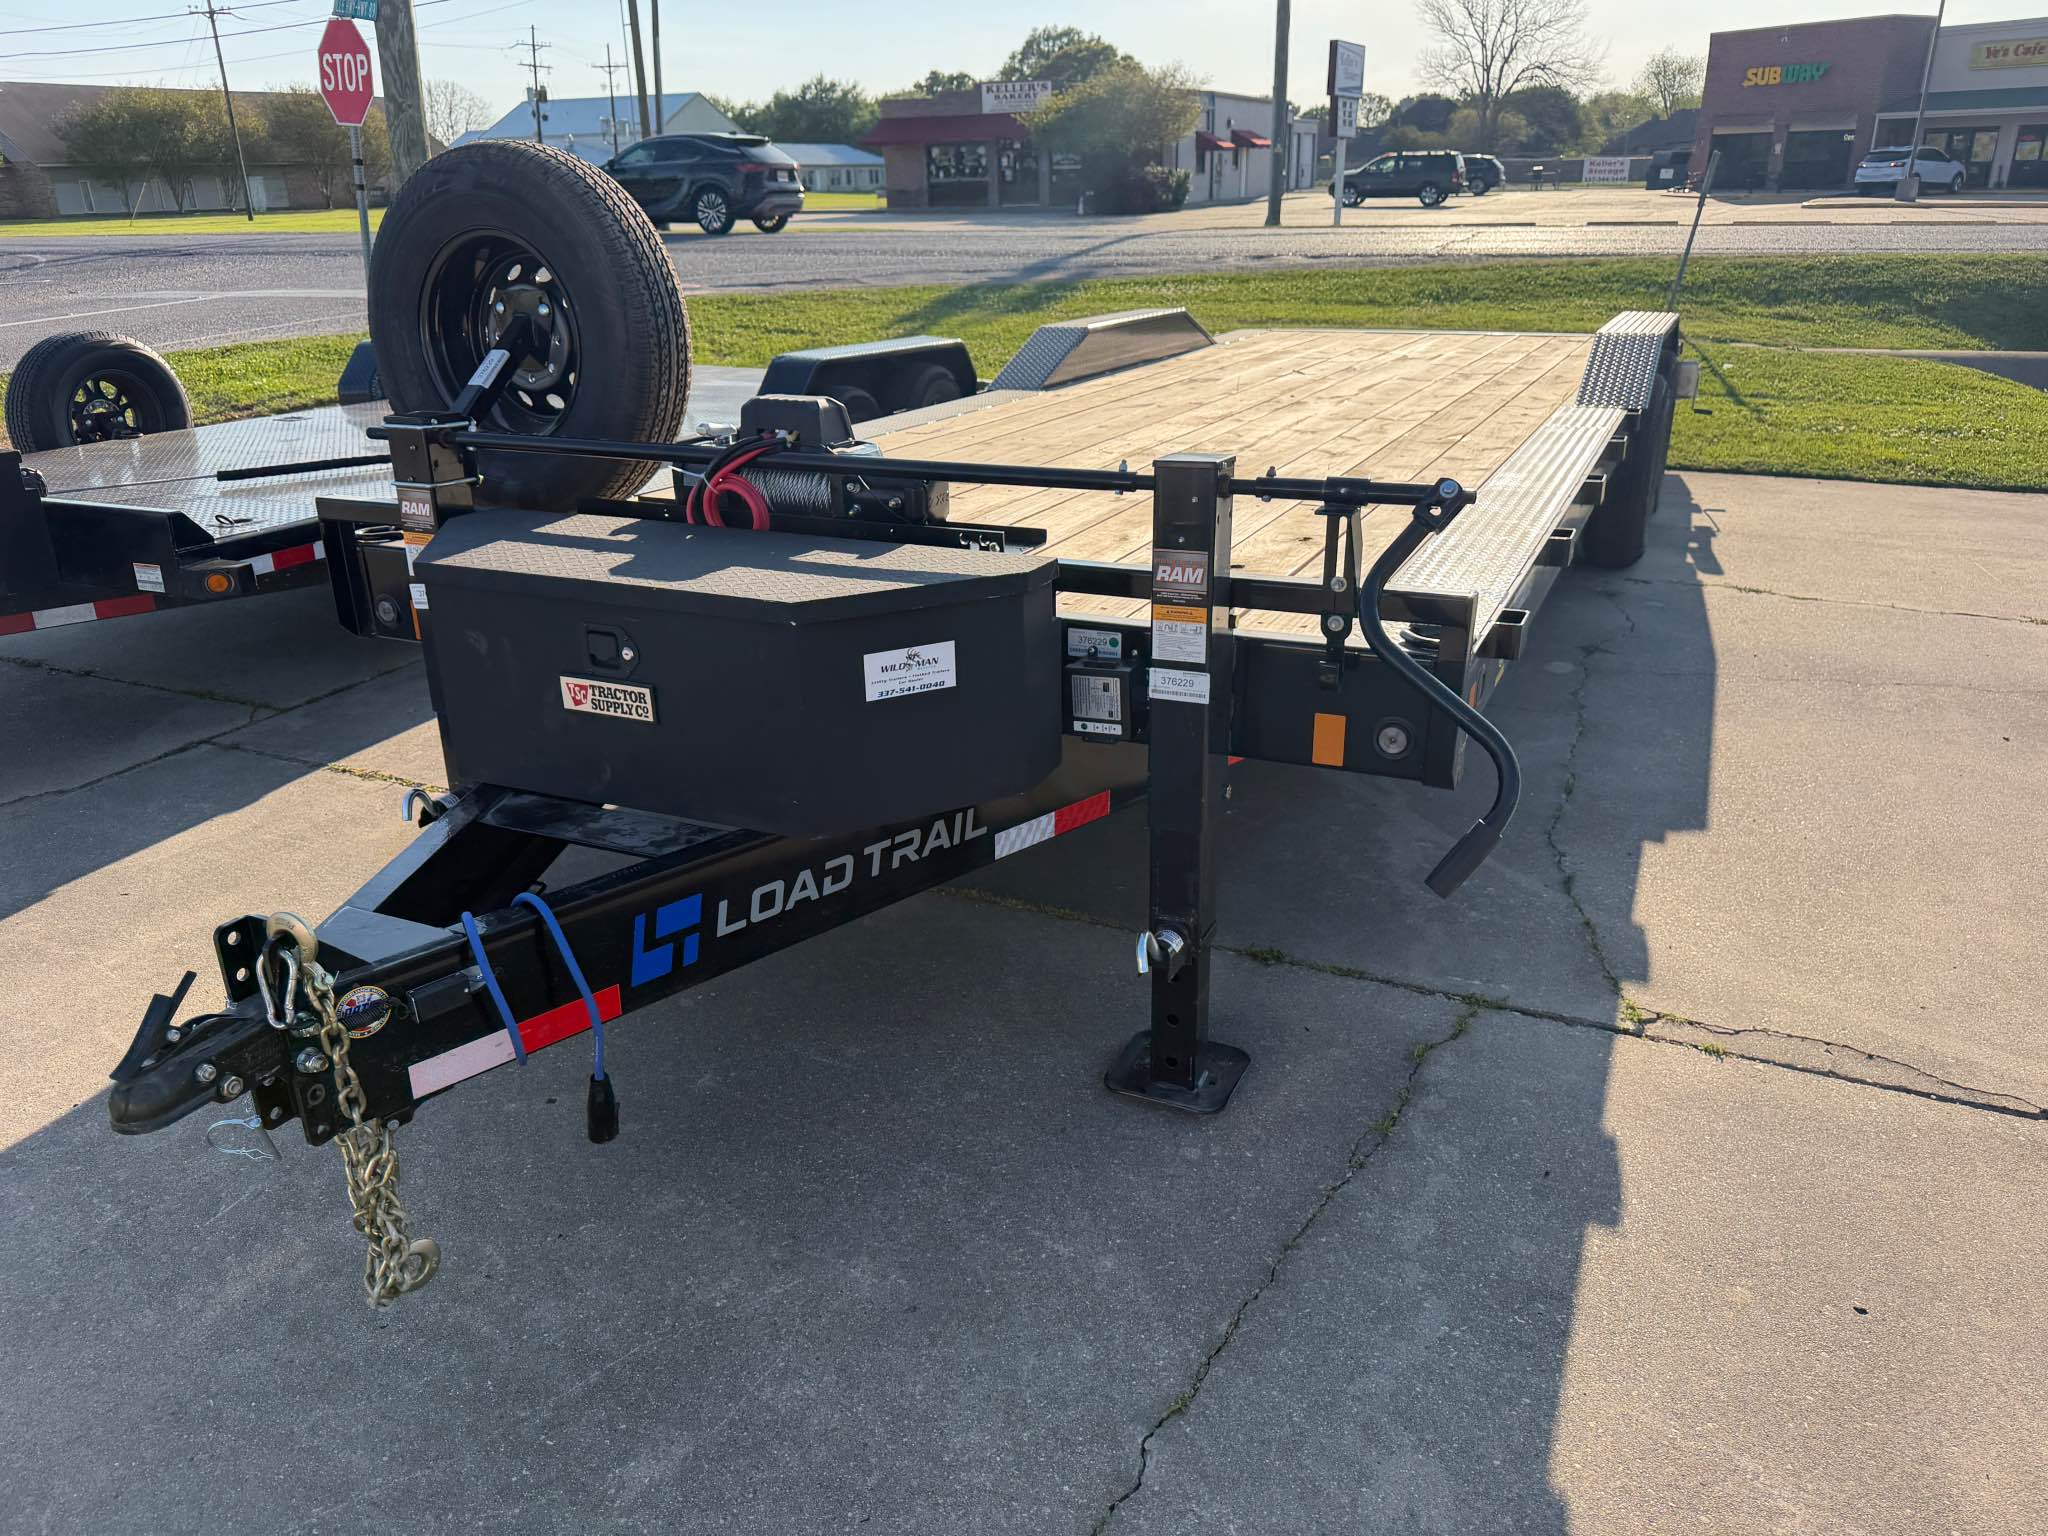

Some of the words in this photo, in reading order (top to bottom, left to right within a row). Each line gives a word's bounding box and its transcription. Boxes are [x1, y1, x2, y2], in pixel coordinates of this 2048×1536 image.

[322, 53, 369, 92] STOP
[1741, 62, 1832, 88] SUBWAY
[985, 81, 1049, 94] KELLER'S
[401, 500, 430, 516] RAM
[1156, 565, 1204, 584] RAM
[1079, 635, 1107, 647] 376229
[881, 662, 907, 673] WILD
[915, 657, 939, 668] MAN
[877, 680, 945, 697] 337-541-0040
[1160, 676, 1194, 688] 376229
[568, 683, 587, 704] TSC
[589, 684, 647, 705] TRACTOR
[591, 698, 634, 716] SUPPLY
[716, 854, 855, 938] LOAD
[863, 807, 988, 878] TRAIL
